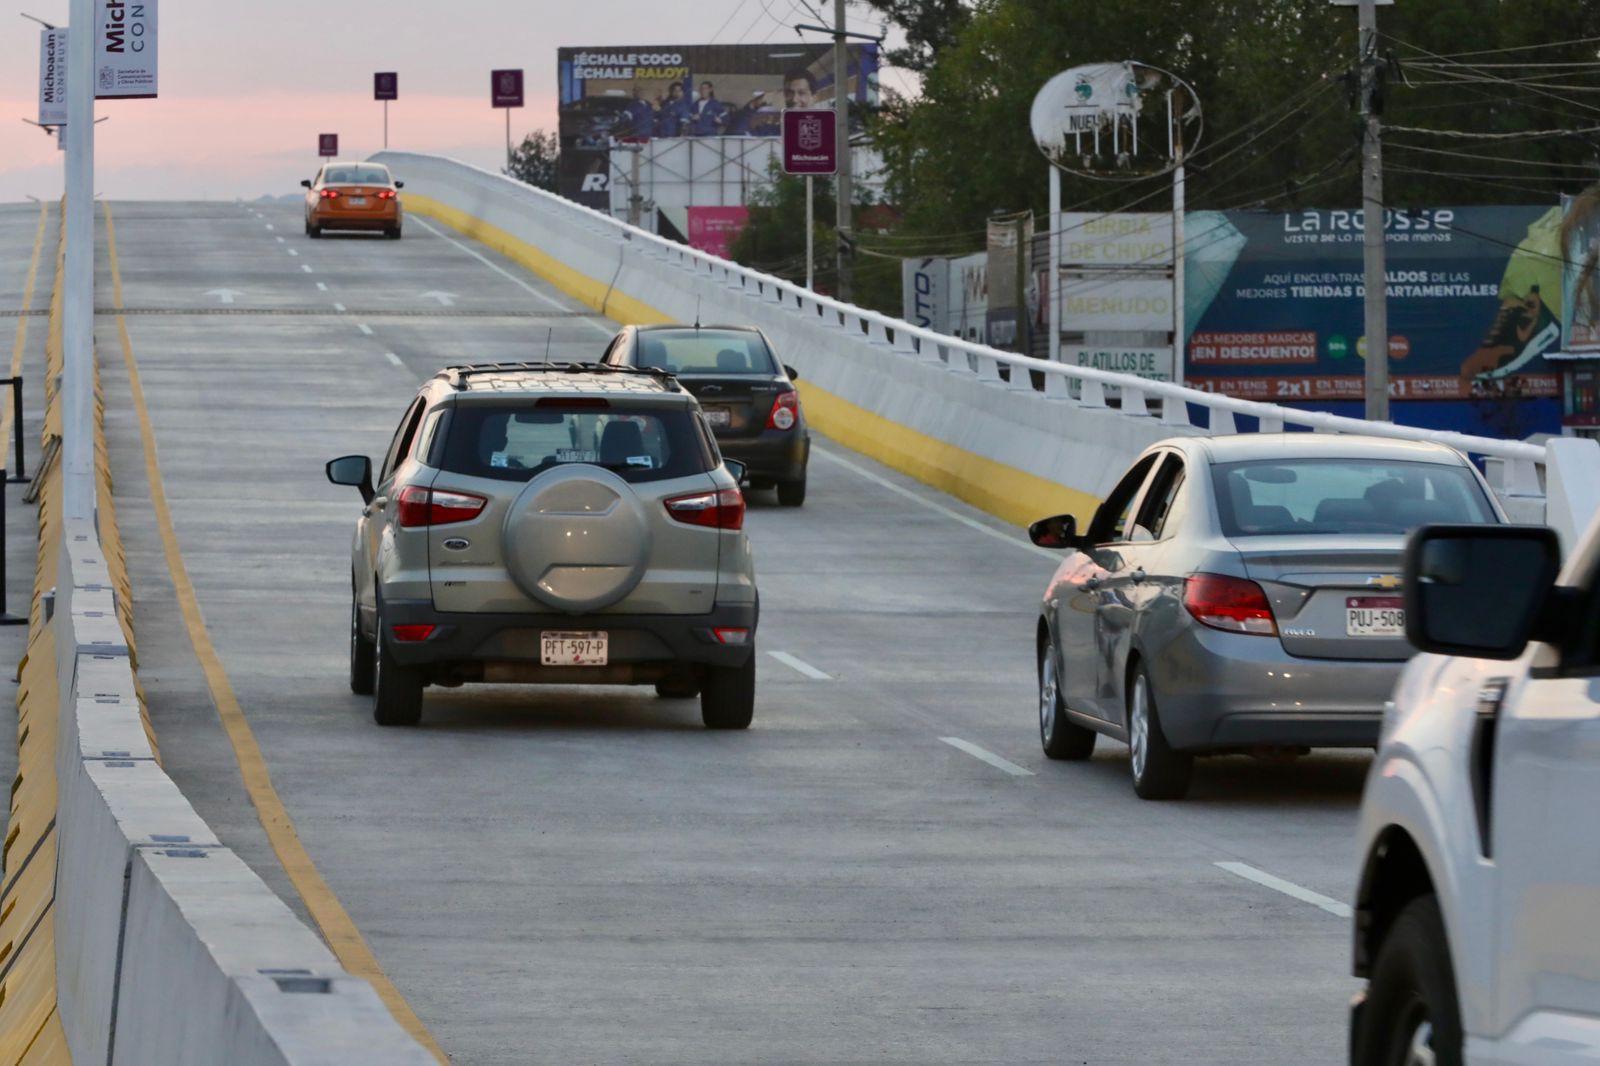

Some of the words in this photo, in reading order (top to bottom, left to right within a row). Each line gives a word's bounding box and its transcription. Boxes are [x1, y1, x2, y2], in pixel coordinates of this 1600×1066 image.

[573, 52, 637, 65] ¡ÉCHALE
[44, 33, 56, 103] Michoacán
[56, 32, 66, 103] CONSTRUYE
[574, 65, 632, 79] ÉCHALE
[635, 66, 689, 79] RALOY!
[1103, 242, 1167, 260] CHIVO
[1264, 272, 1291, 285] AQUÍ
[1385, 271, 1428, 283] ALDOS
[1431, 272, 1447, 282] DE
[1450, 272, 1470, 282] LAS
[1236, 288, 1287, 299] MEJORES
[1290, 286, 1353, 298] TIENDAS
[1067, 297, 1169, 315] MENUDO
[1191, 334, 1211, 344] LAS
[1214, 334, 1265, 344] MEJORES
[1267, 333, 1315, 344] MARCAS
[1220, 345, 1315, 359] DESCUENTO!
[1140, 353, 1155, 371] DE
[1277, 380, 1311, 396] 2x1
[544, 640, 604, 655] PFT-597-P
